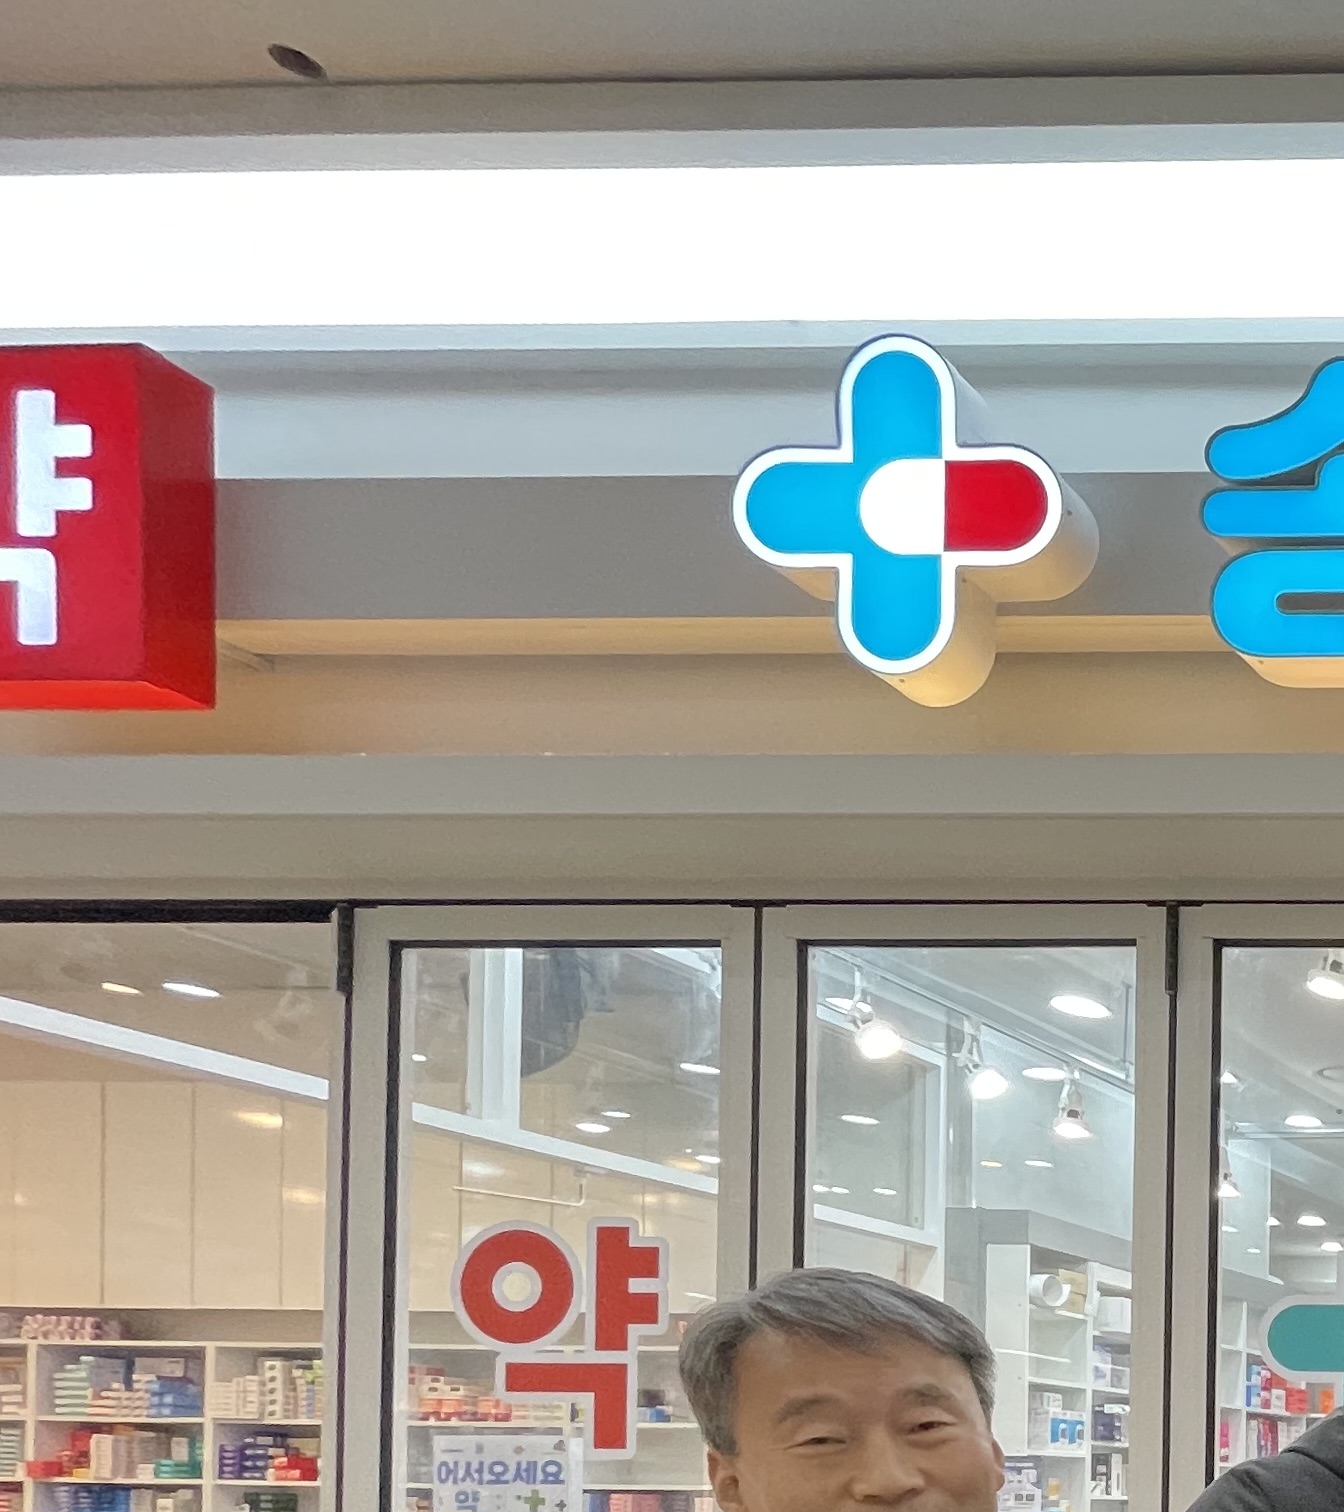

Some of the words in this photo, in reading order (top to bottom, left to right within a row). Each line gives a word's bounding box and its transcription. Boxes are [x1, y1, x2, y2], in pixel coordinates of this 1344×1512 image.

[459, 1226, 661, 1450] 약
[437, 1459, 566, 1485] 어서오세요
[454, 1490, 480, 1512] 약
